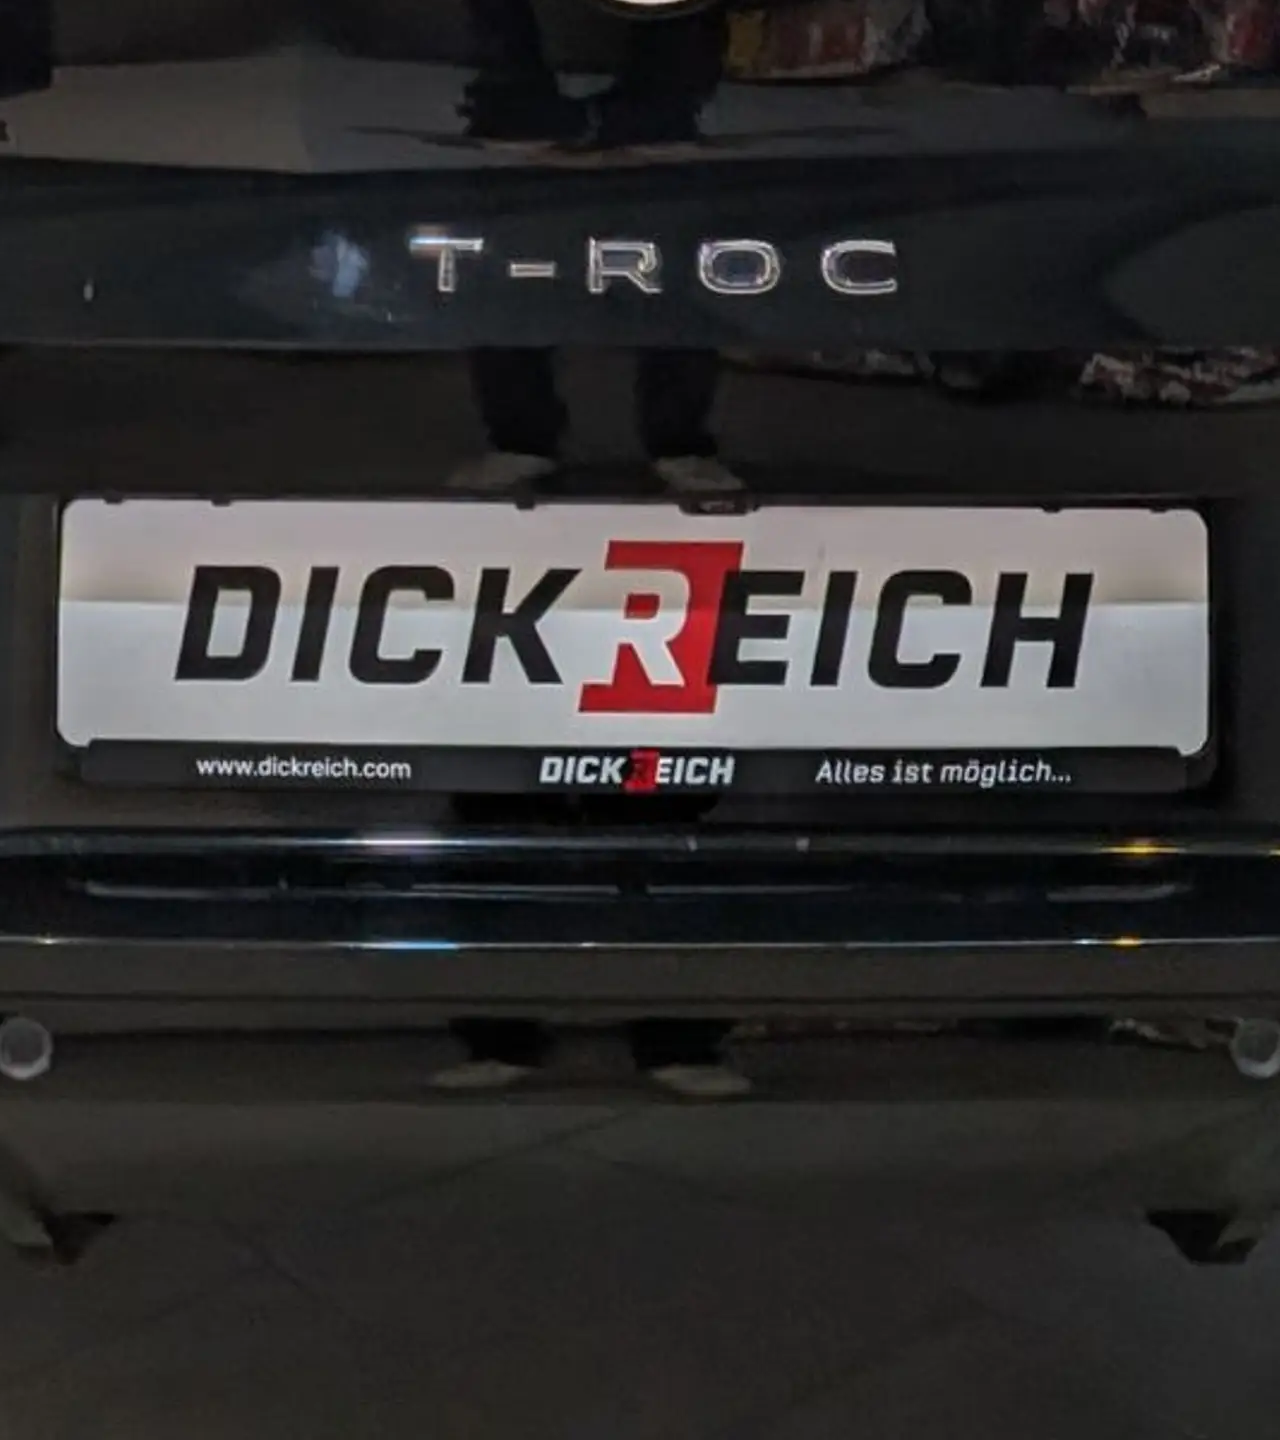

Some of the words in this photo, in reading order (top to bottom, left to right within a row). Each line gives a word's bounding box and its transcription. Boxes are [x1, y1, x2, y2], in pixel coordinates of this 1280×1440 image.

[409, 236, 898, 296] T-ROC
[174, 538, 1095, 716] DICKREICH
[195, 754, 413, 780] www.dickreich.com
[538, 748, 736, 794] DICKREICH
[814, 759, 886, 784] Alles
[891, 759, 934, 785] ist
[939, 758, 1073, 790] möglich...
